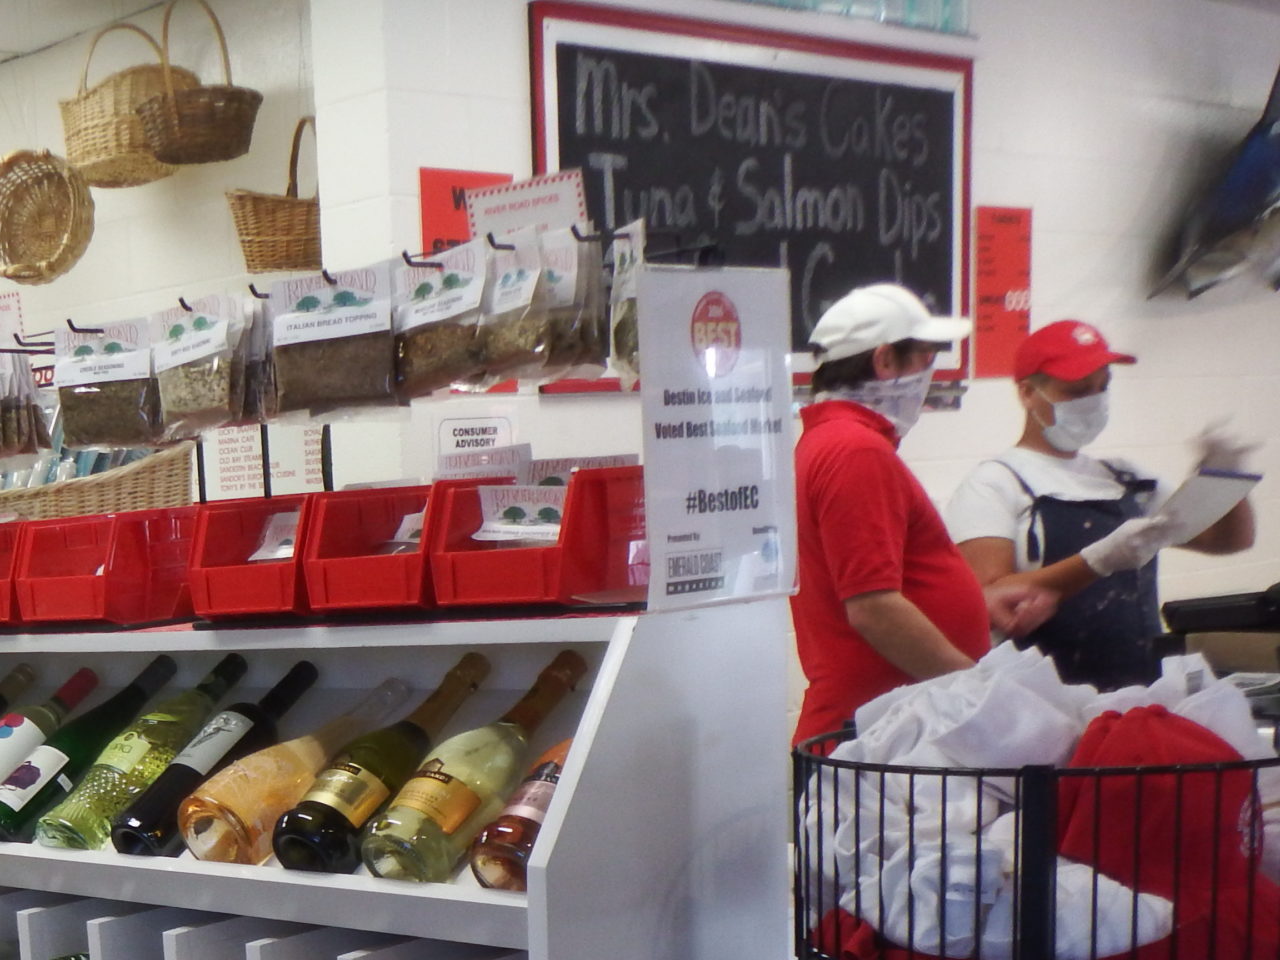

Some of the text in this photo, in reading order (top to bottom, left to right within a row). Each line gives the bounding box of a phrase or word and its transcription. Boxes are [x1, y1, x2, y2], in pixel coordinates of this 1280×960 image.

[575, 50, 930, 167] Mrs. Dean's Cakes
[588, 151, 696, 231] Tuna
[734, 152, 865, 236] Salmon
[878, 167, 943, 259] Dips
[286, 312, 378, 332] ITALIAN BREAD TOPPING
[693, 320, 739, 348] BEST
[663, 388, 696, 407] Destin
[697, 387, 712, 406] Ice
[452, 425, 498, 438] CONSUMER
[655, 421, 685, 440] Voted
[686, 420, 708, 438] Best
[455, 437, 496, 449] ADVISORY
[685, 484, 760, 515] #BestofEC
[667, 551, 723, 579] EMERALD COAST
